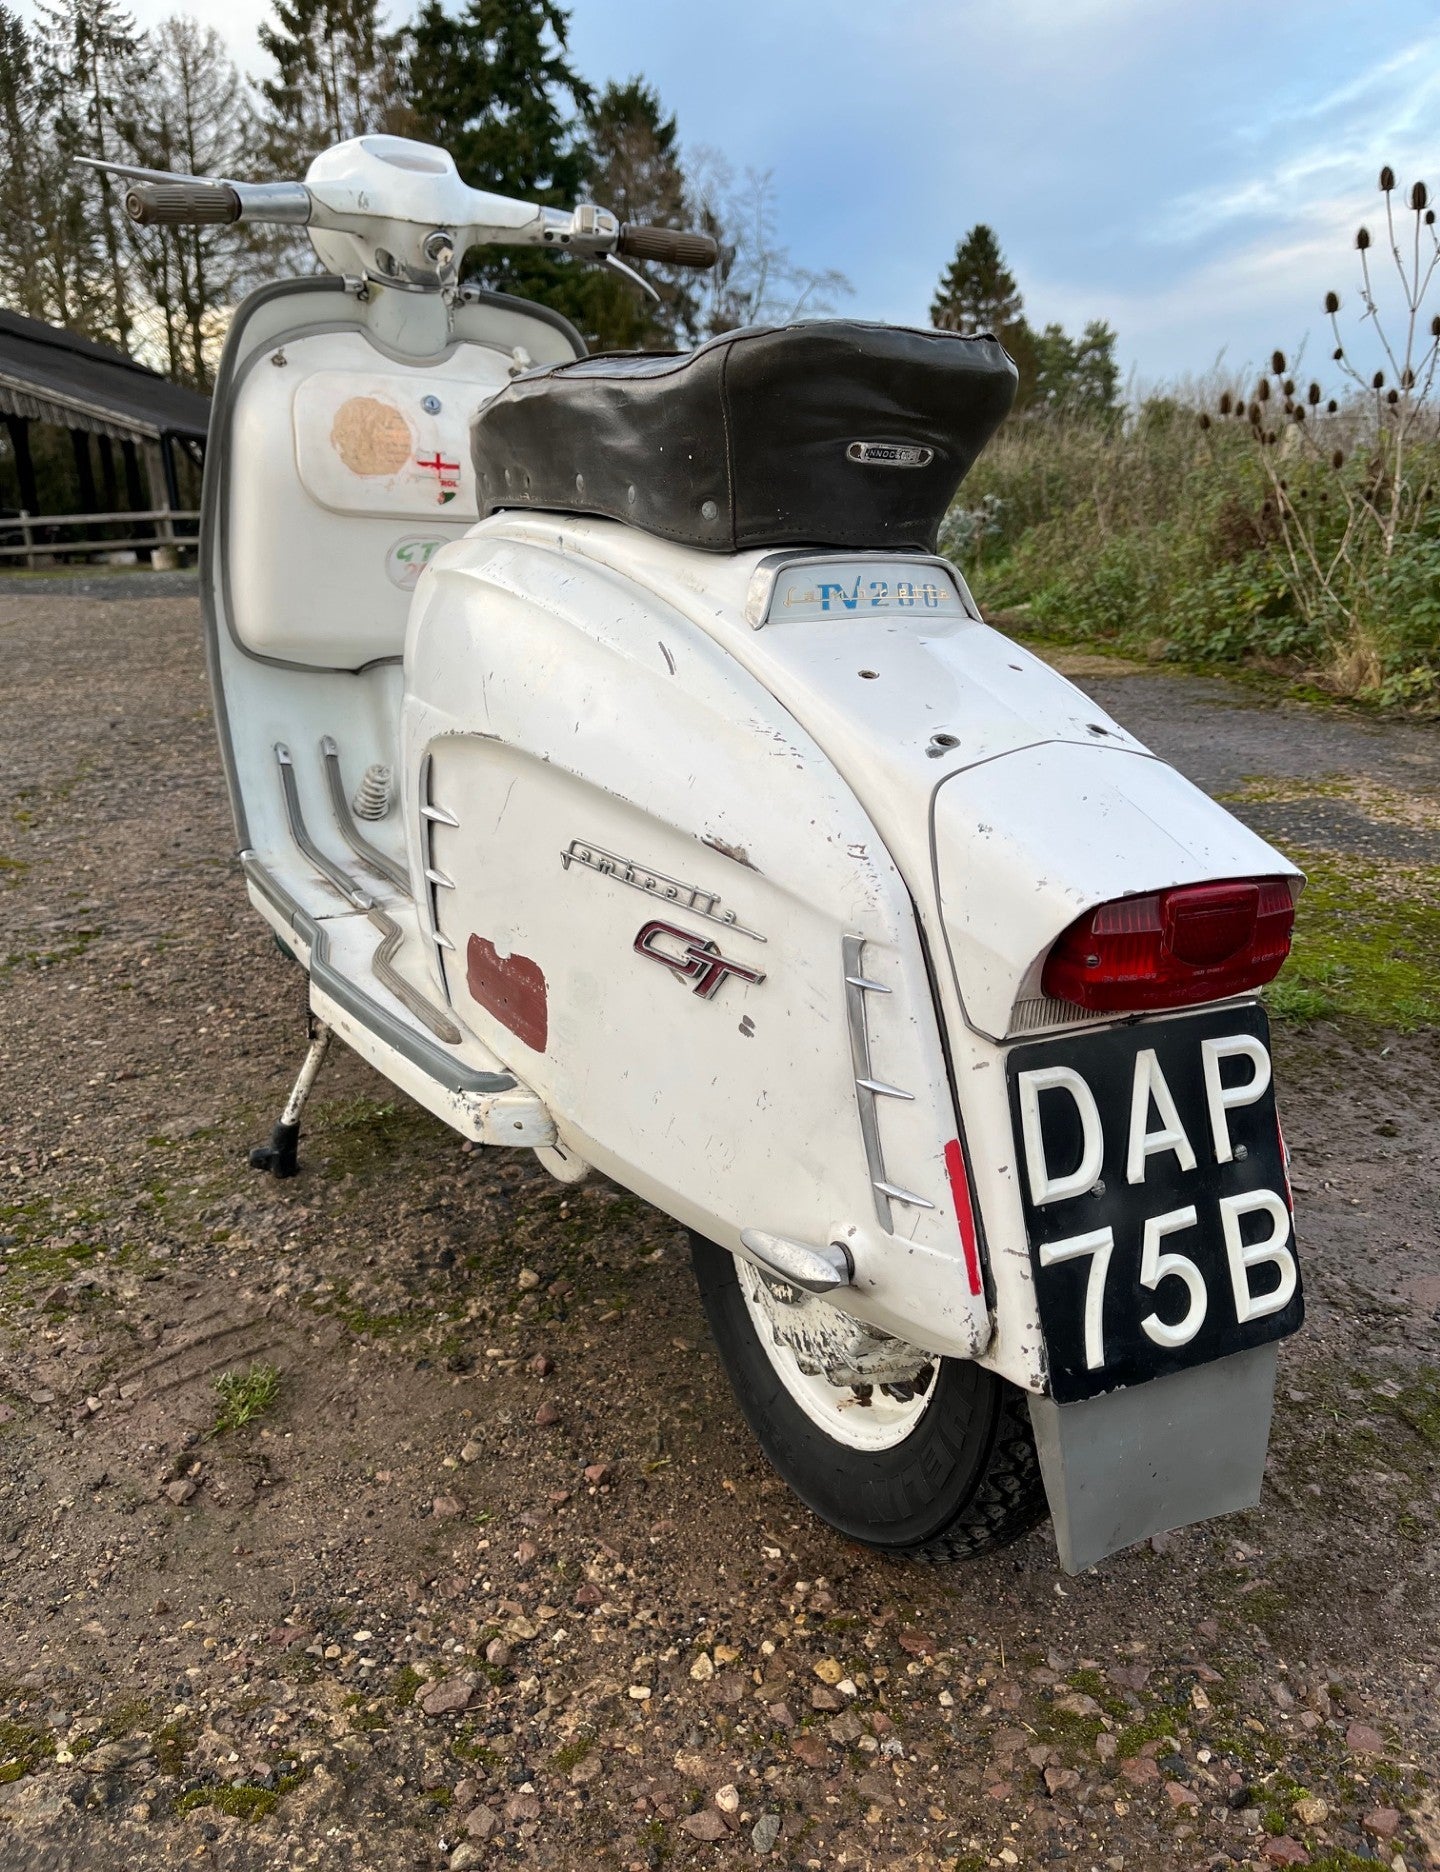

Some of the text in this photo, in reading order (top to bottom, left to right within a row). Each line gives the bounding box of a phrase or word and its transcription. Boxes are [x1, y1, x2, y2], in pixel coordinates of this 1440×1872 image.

[633, 919, 767, 1001] GT
[1018, 1034, 1272, 1206] DAP
[1039, 1188, 1298, 1370] 75B
